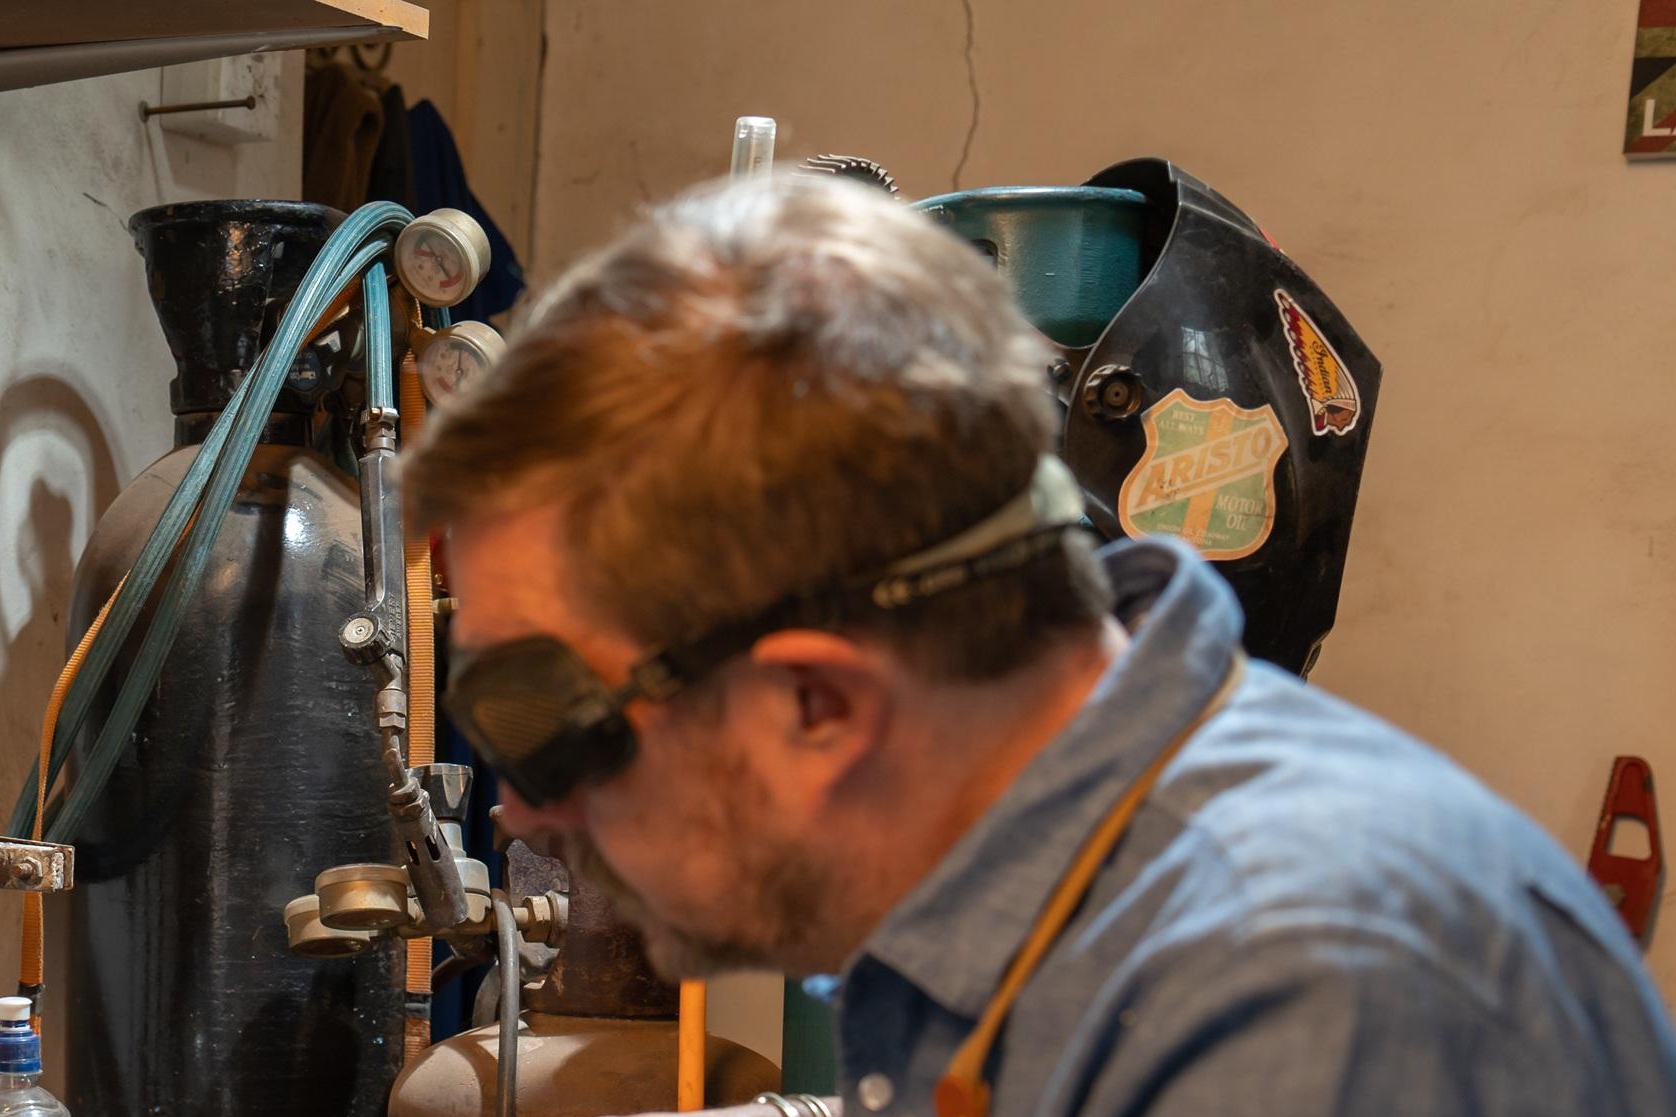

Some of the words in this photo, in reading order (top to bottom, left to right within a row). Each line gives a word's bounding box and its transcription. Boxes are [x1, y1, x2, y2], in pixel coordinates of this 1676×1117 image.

[1136, 426, 1272, 508] ARISTO
[1216, 495, 1263, 515] MOTOR
[1226, 515, 1248, 531] OIL
